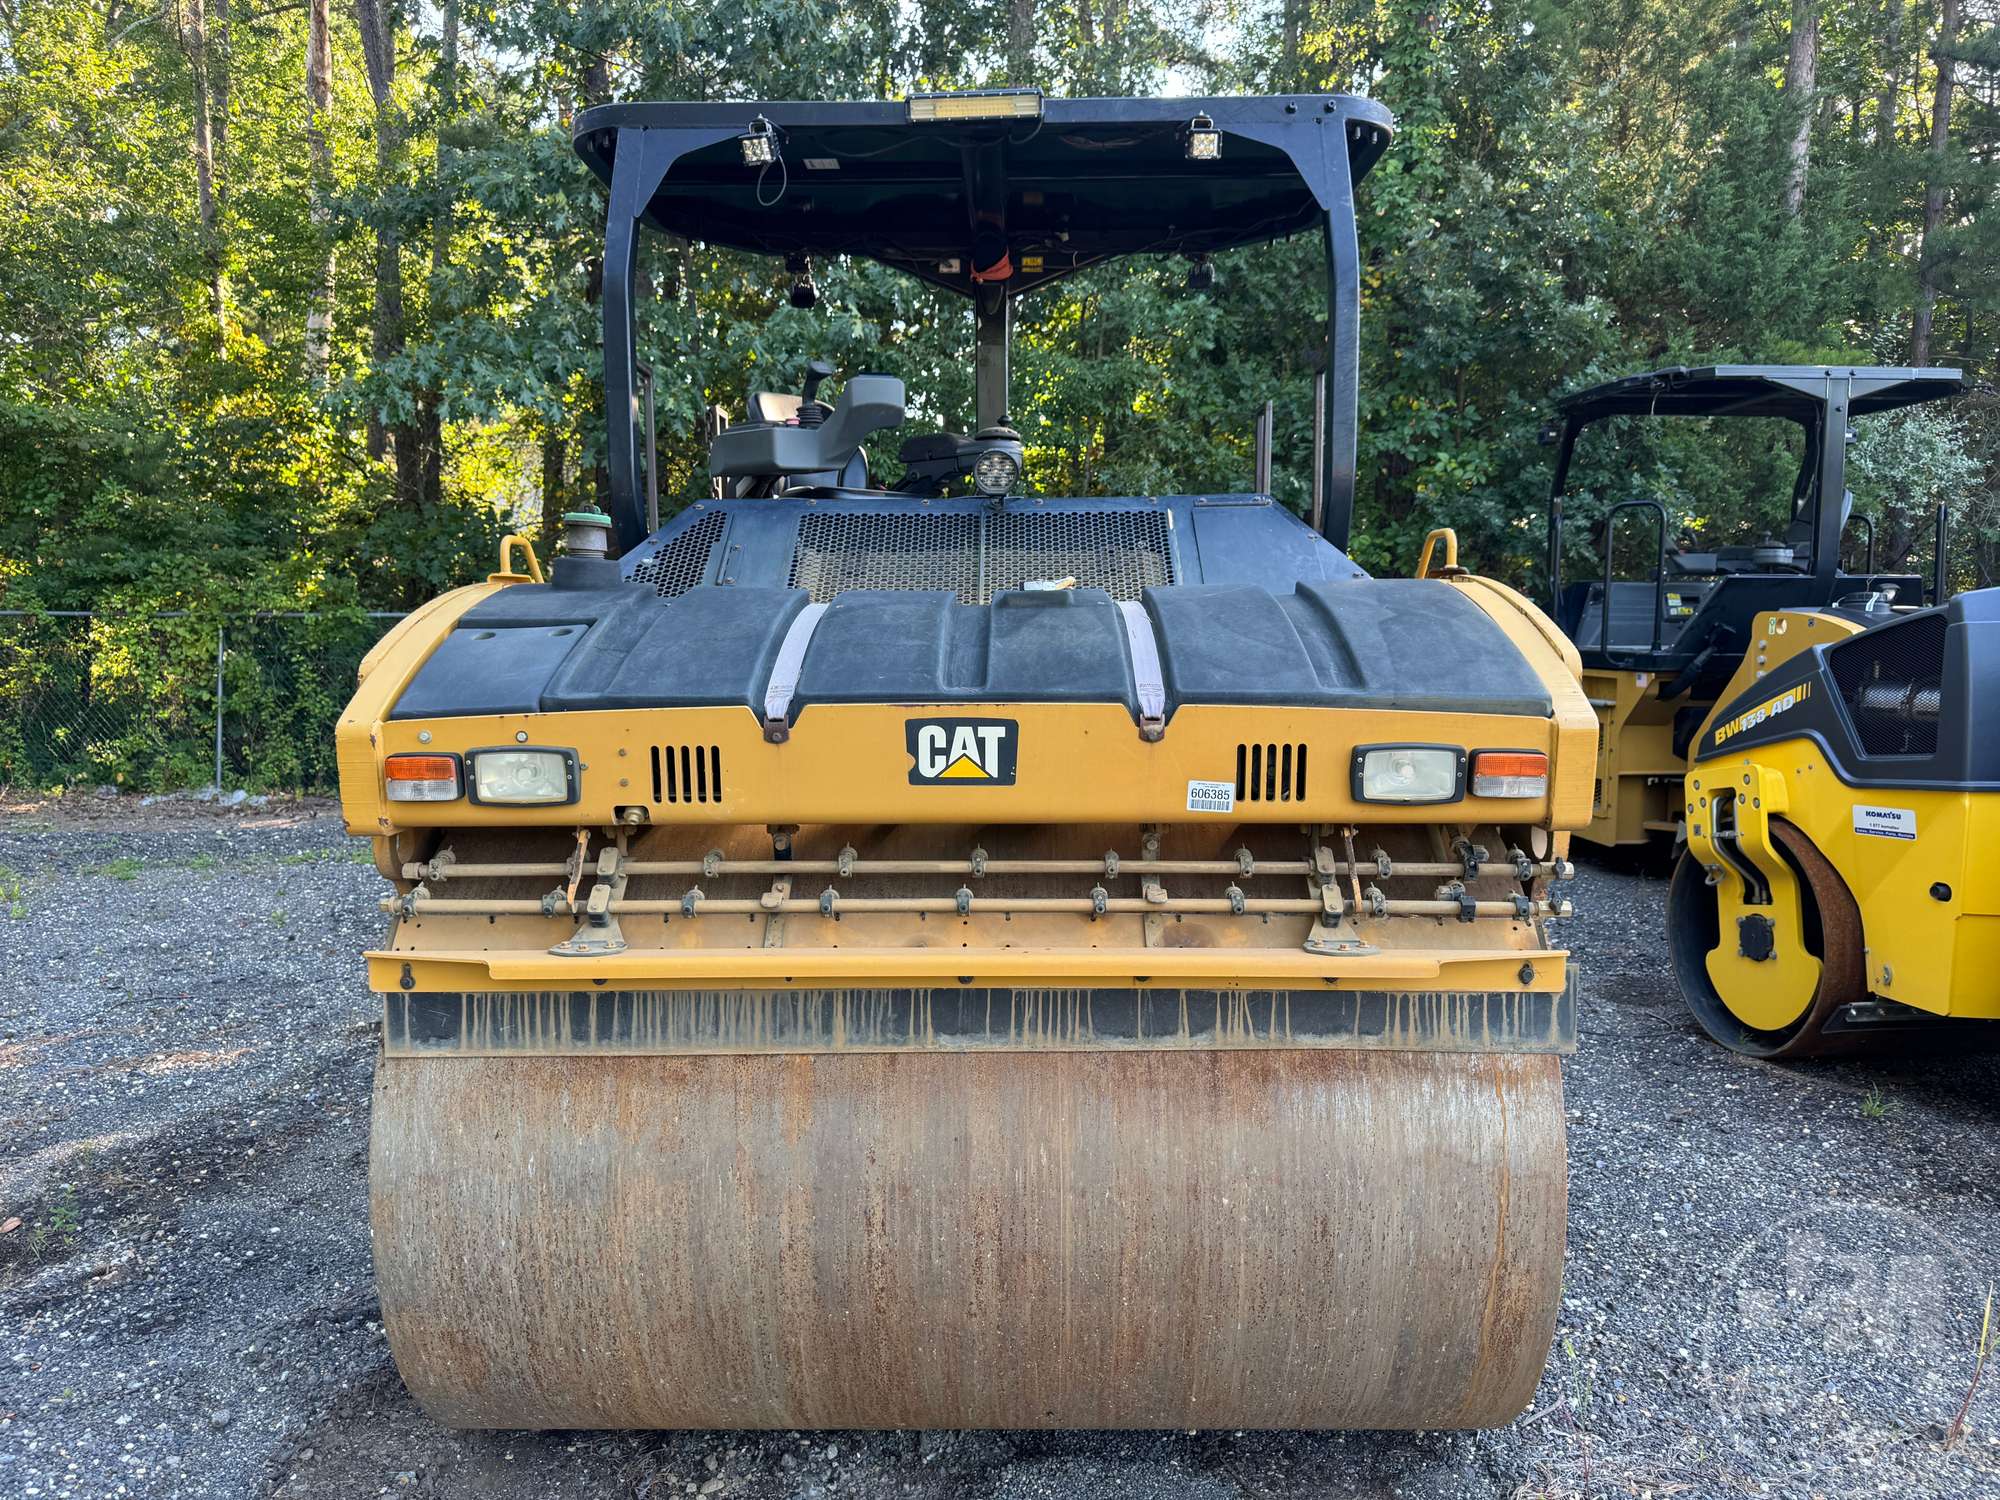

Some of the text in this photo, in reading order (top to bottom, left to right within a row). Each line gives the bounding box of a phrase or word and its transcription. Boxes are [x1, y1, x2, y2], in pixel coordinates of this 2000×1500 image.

[1770, 694, 1795, 718] AD
[918, 725, 1006, 778] CAT
[1191, 788, 1230, 800] 606385
[1865, 810, 1902, 820] KOMATSU
